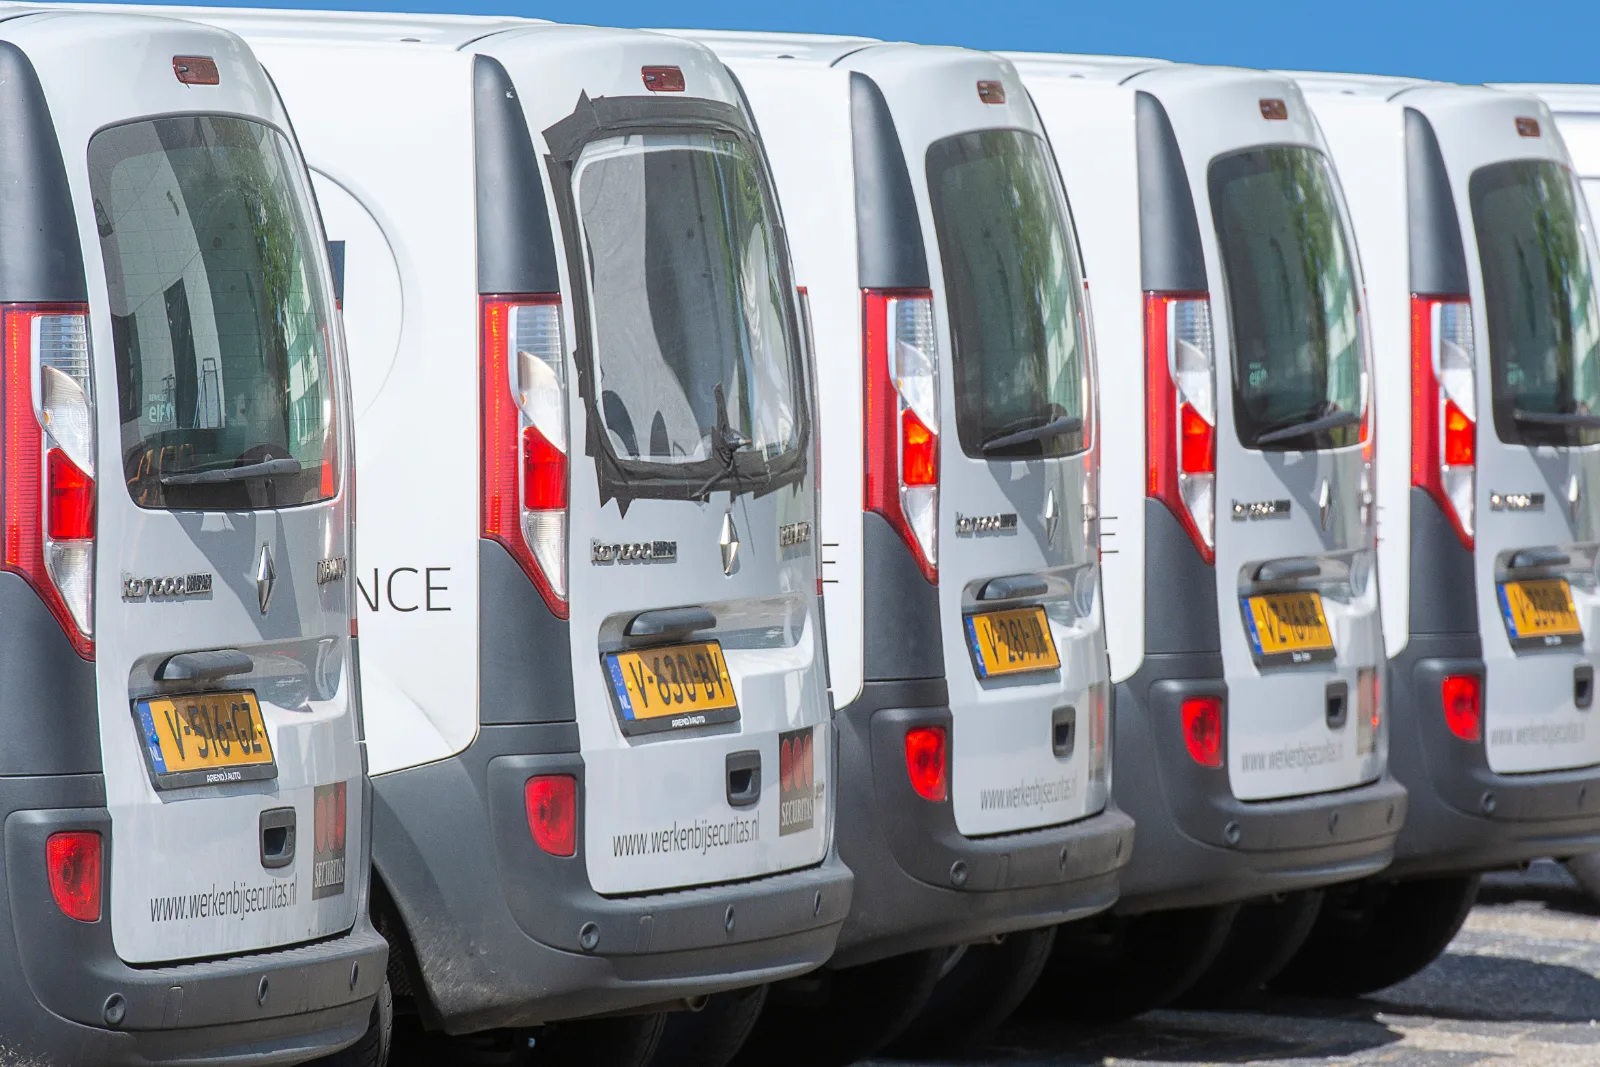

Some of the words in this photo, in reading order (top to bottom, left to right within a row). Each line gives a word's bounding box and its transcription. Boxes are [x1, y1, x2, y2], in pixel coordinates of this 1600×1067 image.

[148, 403, 165, 423] elf
[628, 651, 725, 709] V-630-BV
[618, 694, 631, 710] NL
[164, 701, 263, 761] V-516-GZ
[149, 745, 163, 762] NL
[781, 797, 814, 827] SECURITAS
[612, 810, 760, 858] www.werkenbijsecuritas.nl
[314, 858, 345, 888] SECURITAS
[150, 872, 298, 922] www.werkenbijsecuritas.nl
